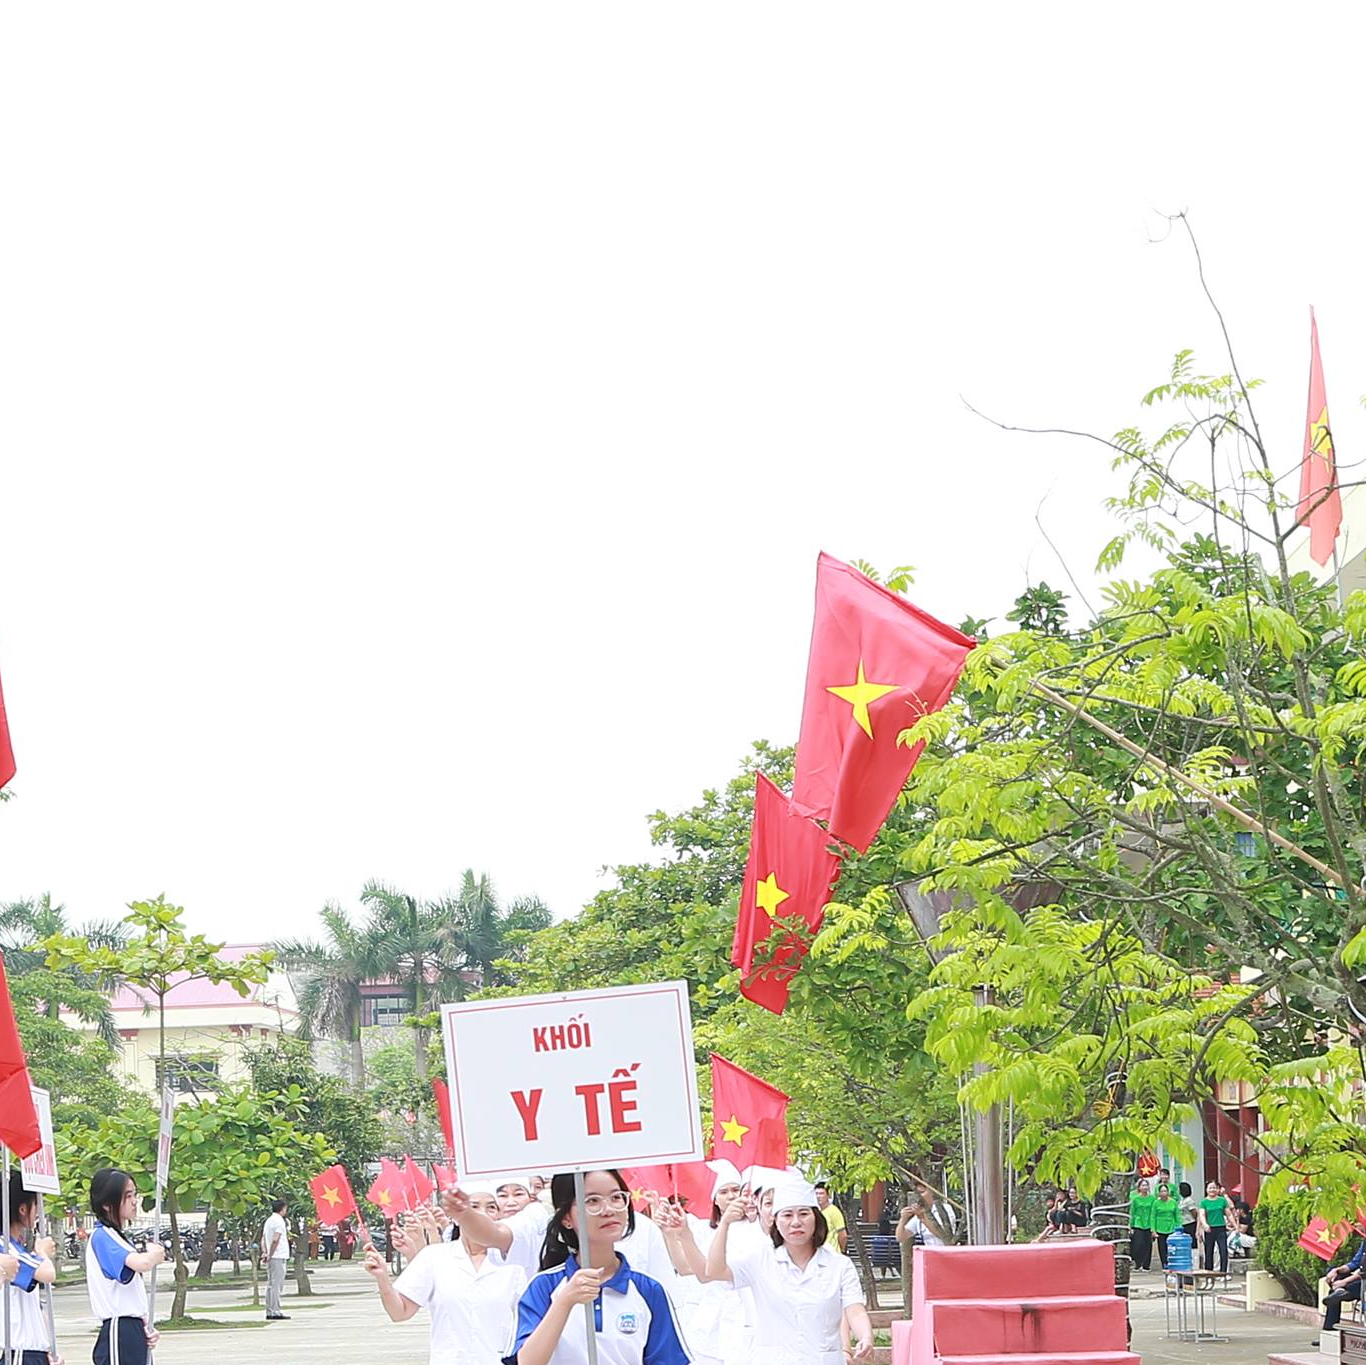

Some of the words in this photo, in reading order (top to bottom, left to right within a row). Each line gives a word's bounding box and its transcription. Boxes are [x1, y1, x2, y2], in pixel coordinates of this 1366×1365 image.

[532, 1013, 592, 1052] KHỐI
[510, 1088, 544, 1141] Y
[574, 1062, 642, 1136] TẾ
